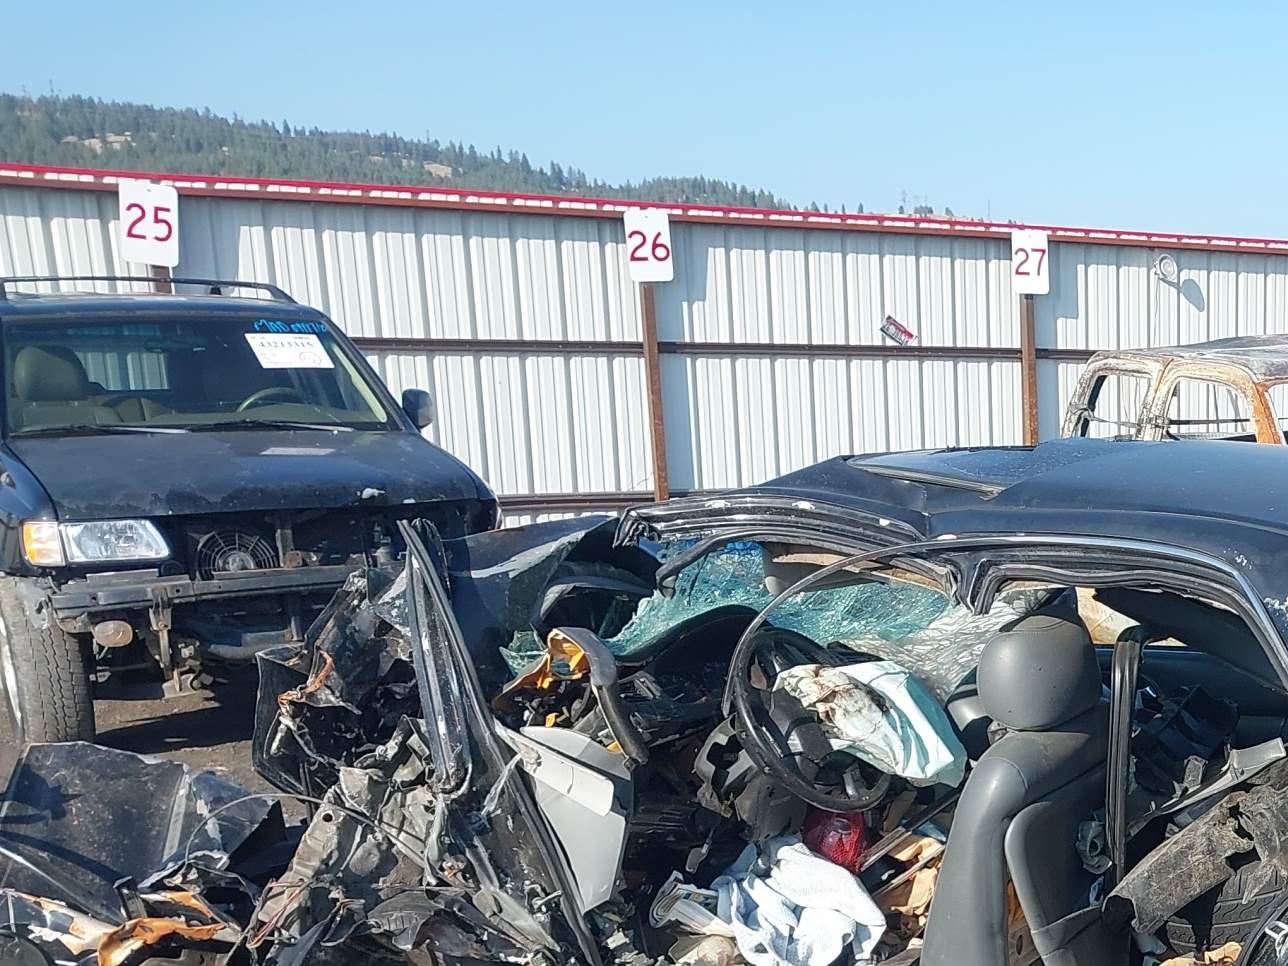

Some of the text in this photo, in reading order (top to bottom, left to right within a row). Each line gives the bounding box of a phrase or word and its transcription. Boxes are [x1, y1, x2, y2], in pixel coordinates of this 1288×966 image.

[126, 203, 172, 242] 25
[628, 230, 670, 262] 26
[1014, 248, 1046, 276] 27
